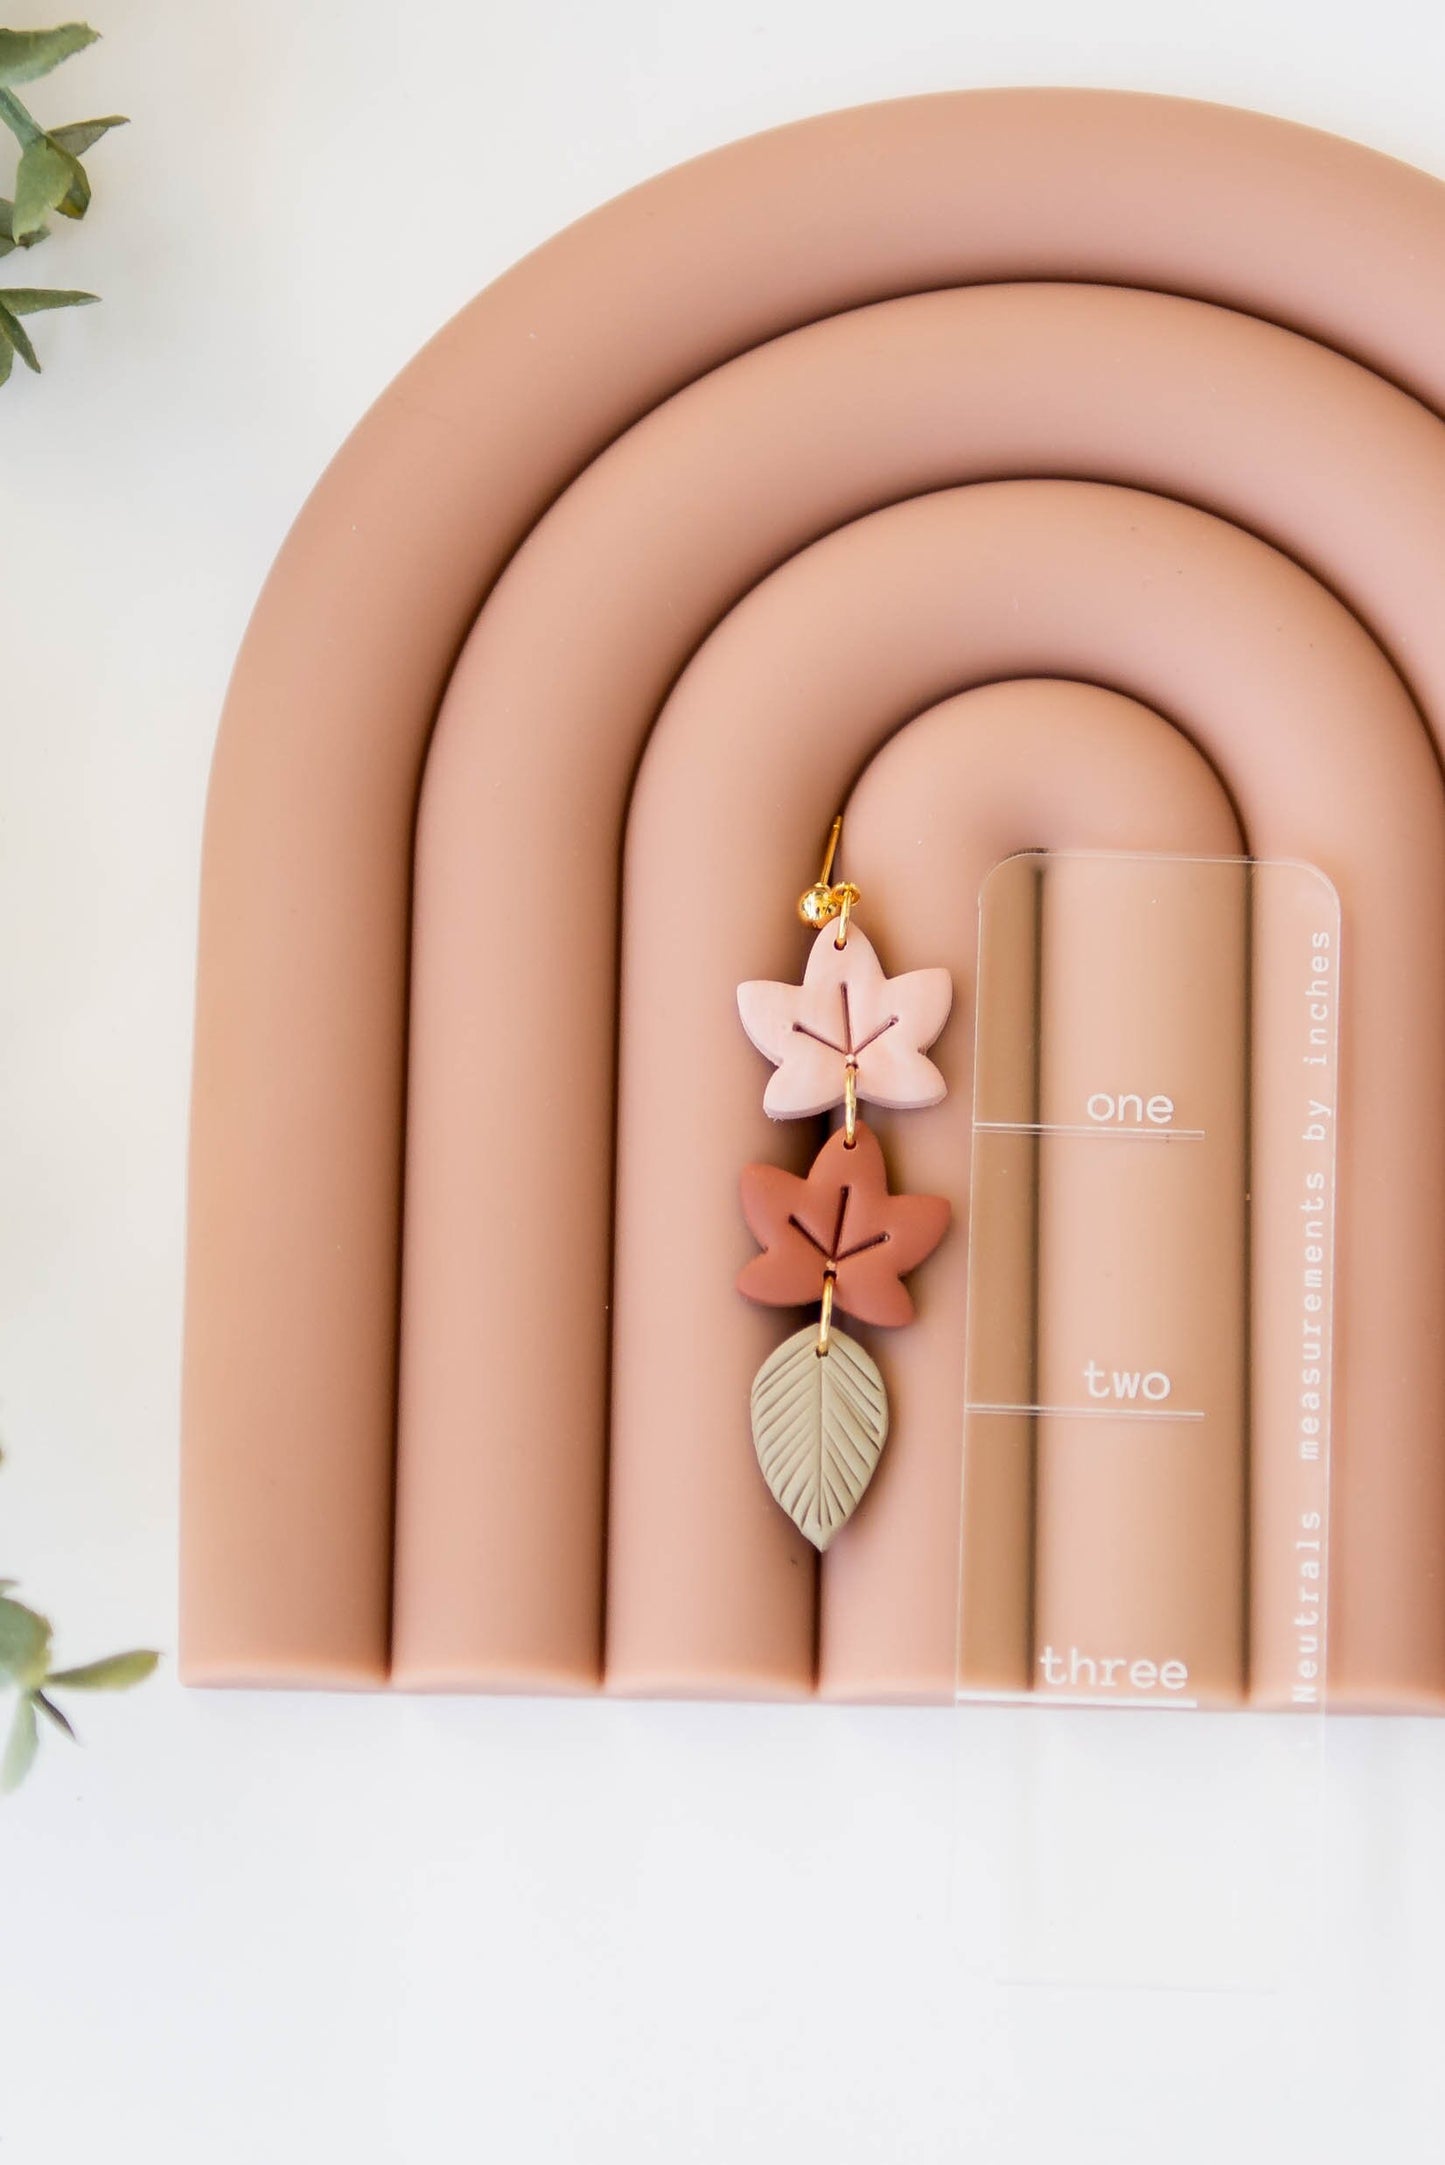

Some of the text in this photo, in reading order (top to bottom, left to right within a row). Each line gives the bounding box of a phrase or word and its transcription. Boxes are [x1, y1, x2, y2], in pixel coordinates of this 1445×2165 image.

[1303, 931, 1330, 1064] inches
[1087, 1093, 1174, 1124] one
[1302, 1099, 1331, 1141] by
[1299, 1172, 1324, 1460] measurements
[1084, 1359, 1171, 1401] two
[1292, 1511, 1321, 1703] Neutrals
[1039, 1644, 1189, 1690] three
